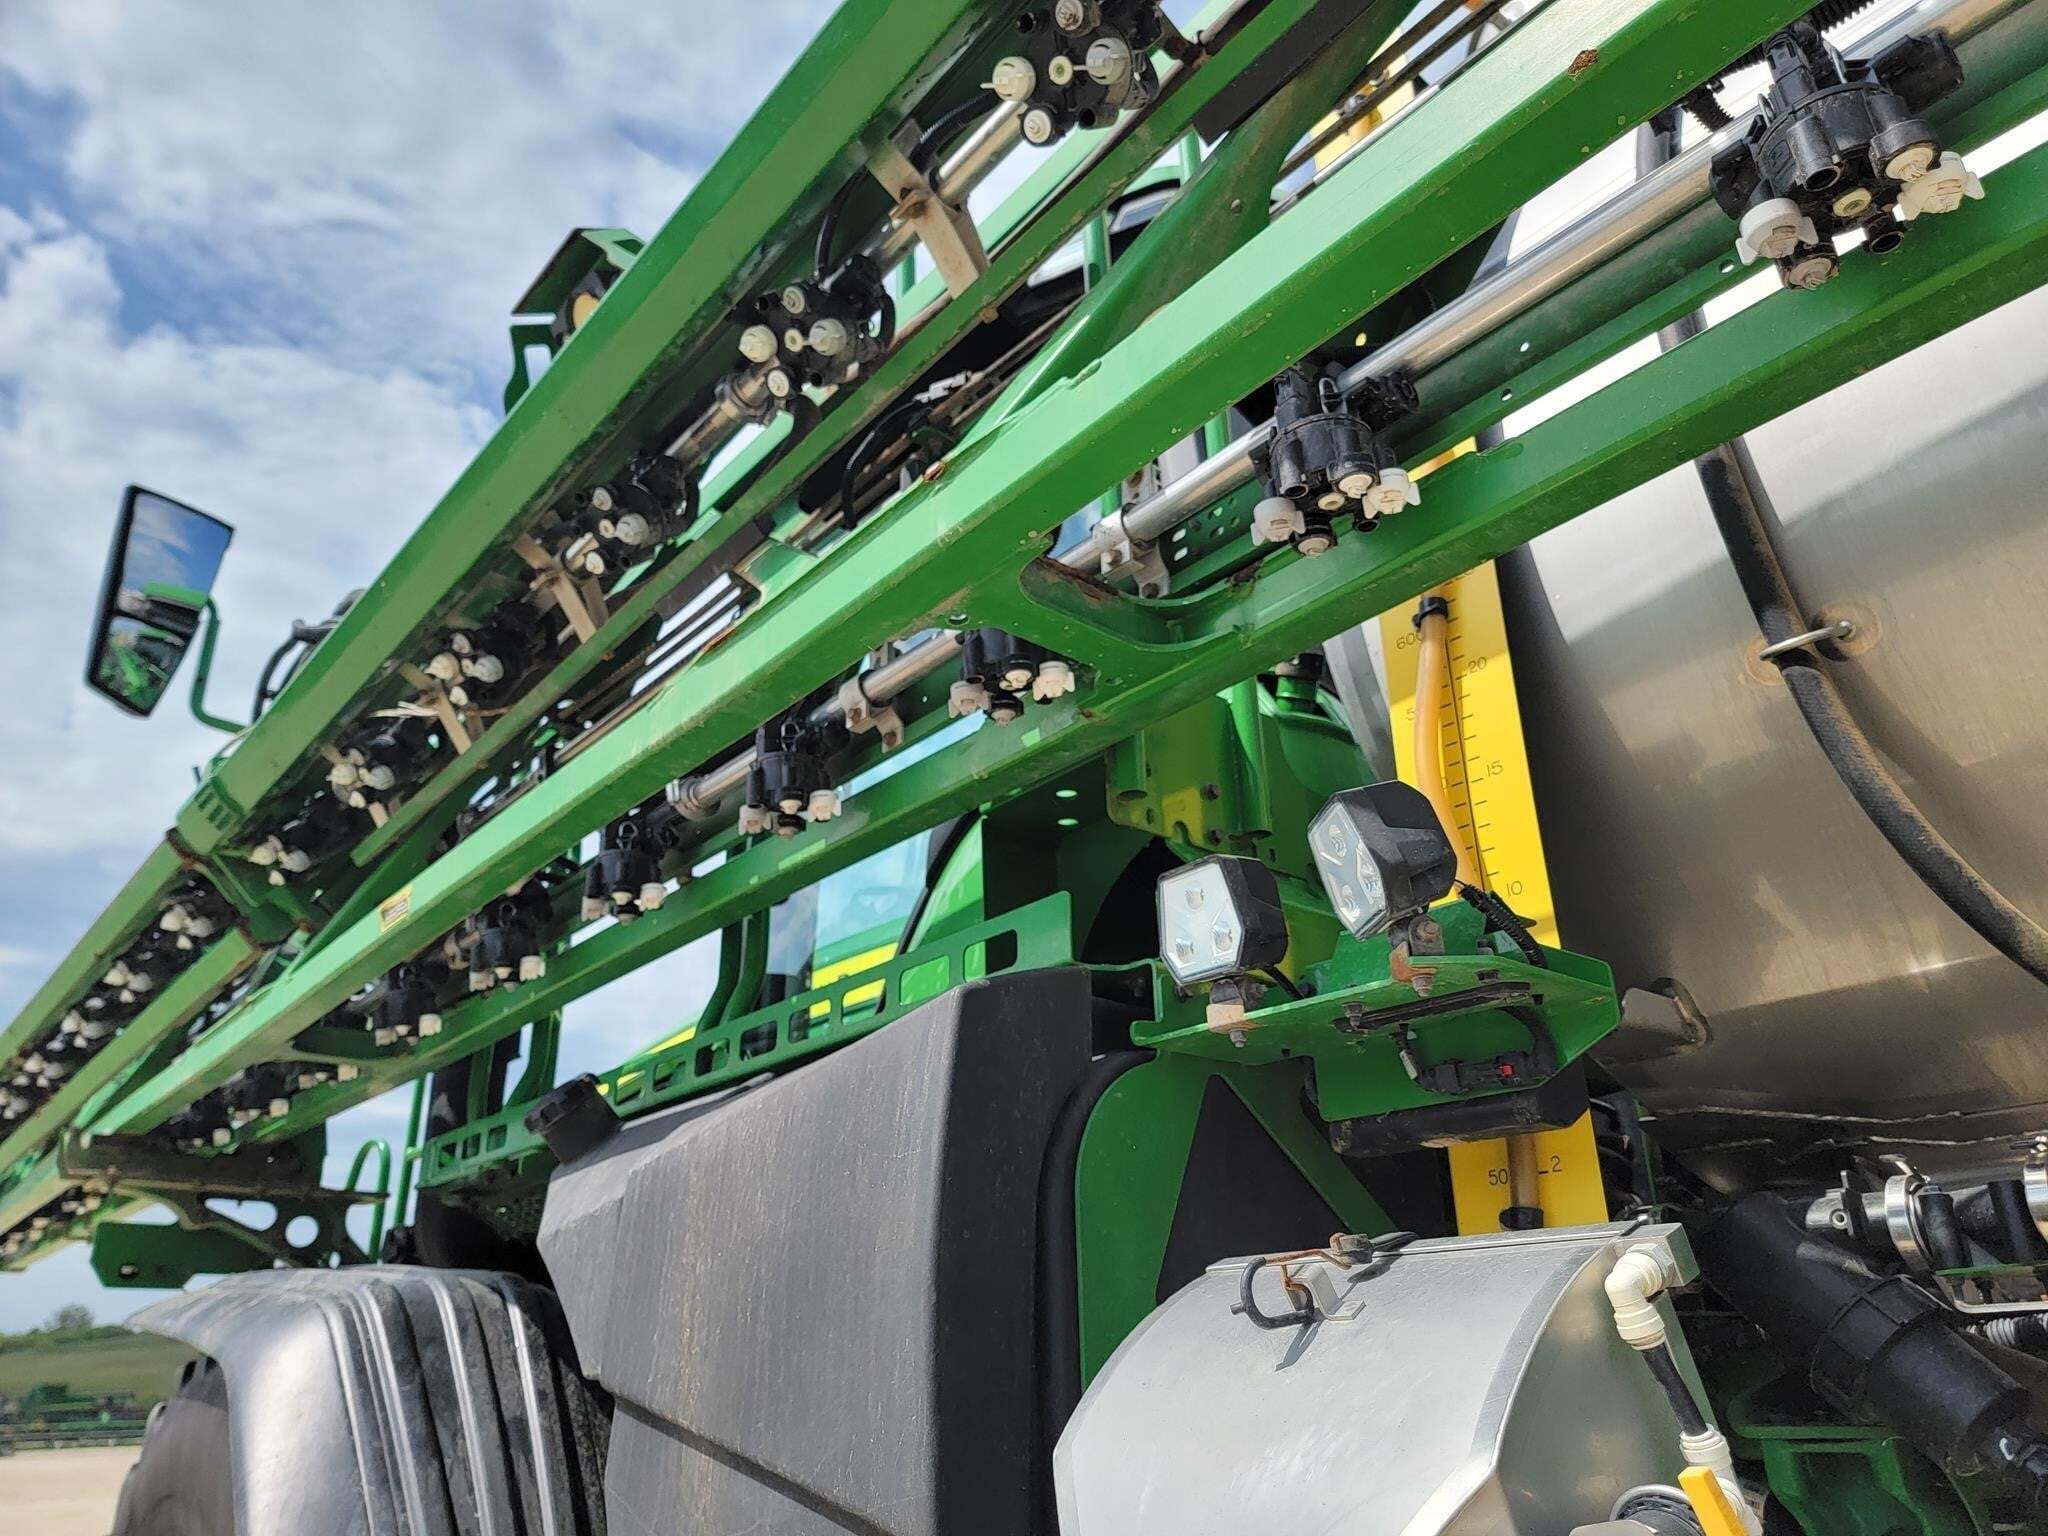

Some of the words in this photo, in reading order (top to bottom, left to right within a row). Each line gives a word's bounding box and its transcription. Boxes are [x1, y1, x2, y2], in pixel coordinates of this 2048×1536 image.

[1468, 657, 1487, 674] 20
[1486, 761, 1503, 778] 15
[1507, 881, 1523, 897] 10
[1551, 1155, 1563, 1173] 2
